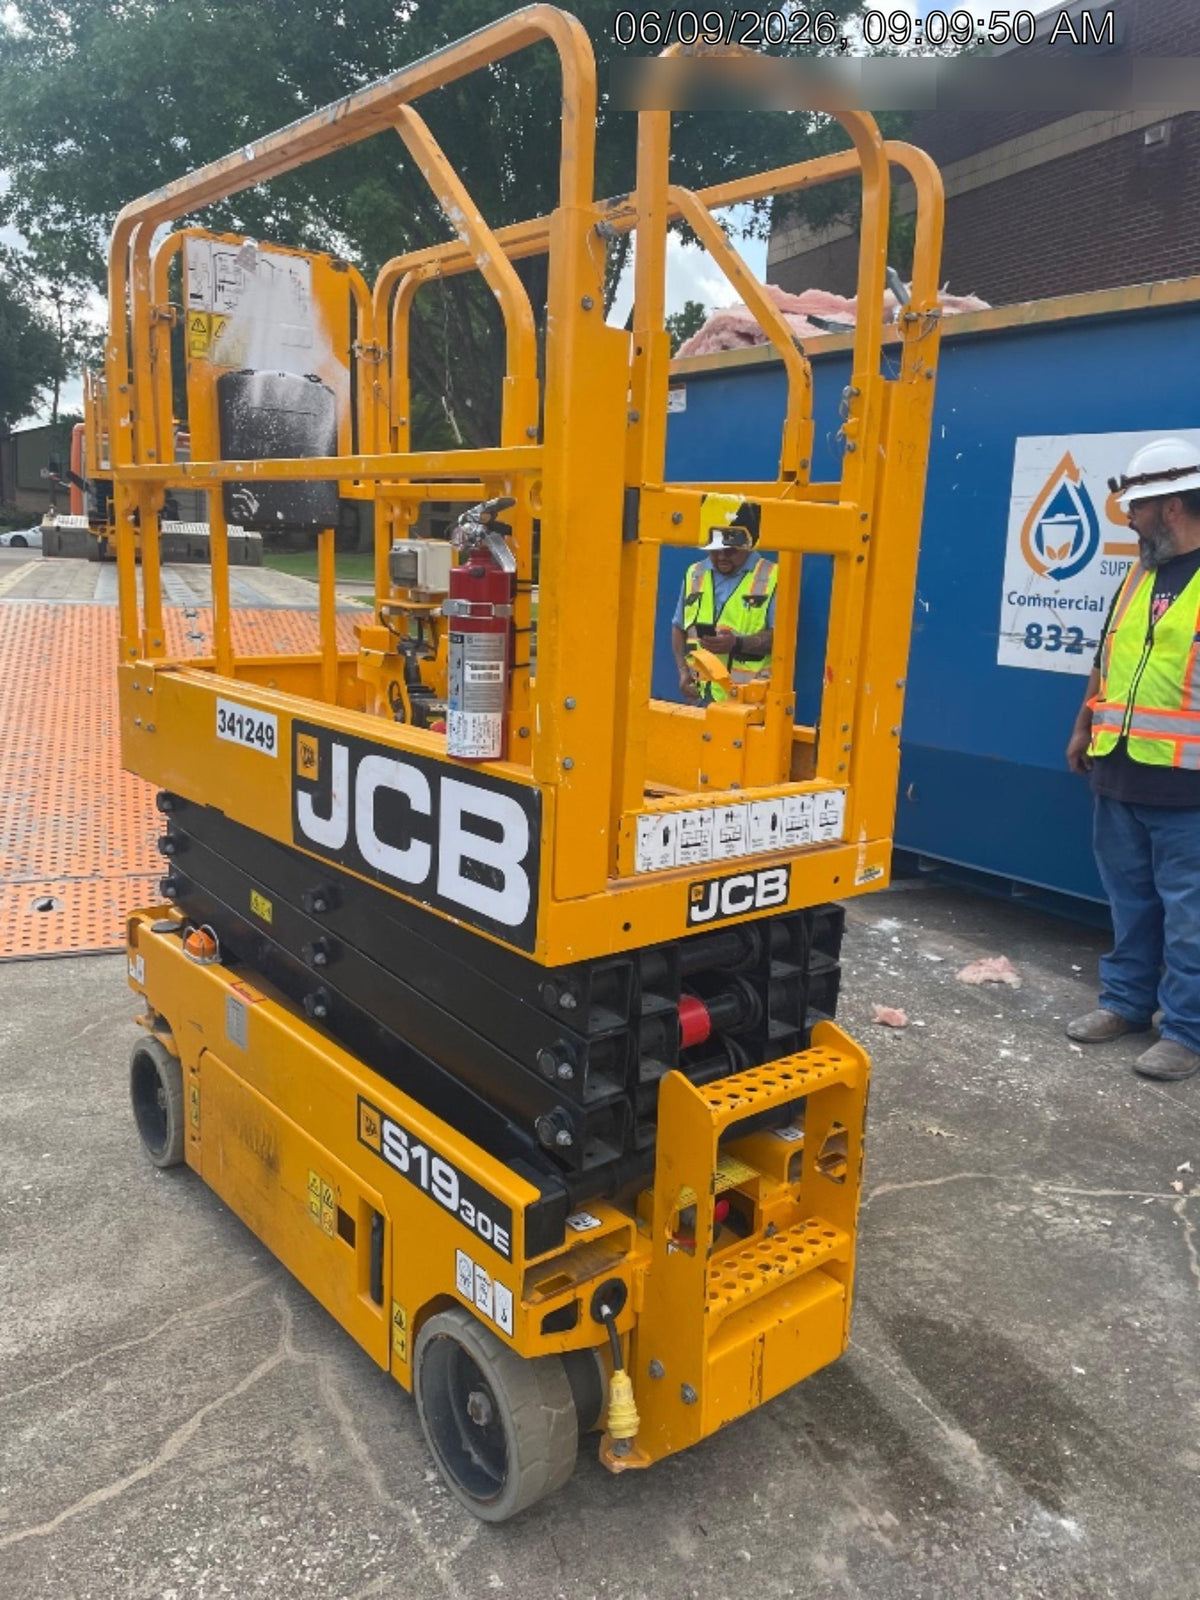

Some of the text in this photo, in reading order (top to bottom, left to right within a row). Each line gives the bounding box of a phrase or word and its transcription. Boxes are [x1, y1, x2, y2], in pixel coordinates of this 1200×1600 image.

[1007, 591, 1105, 612] Commercial
[218, 708, 275, 751] 341249
[297, 742, 531, 928] JCB
[690, 868, 789, 922] JCB
